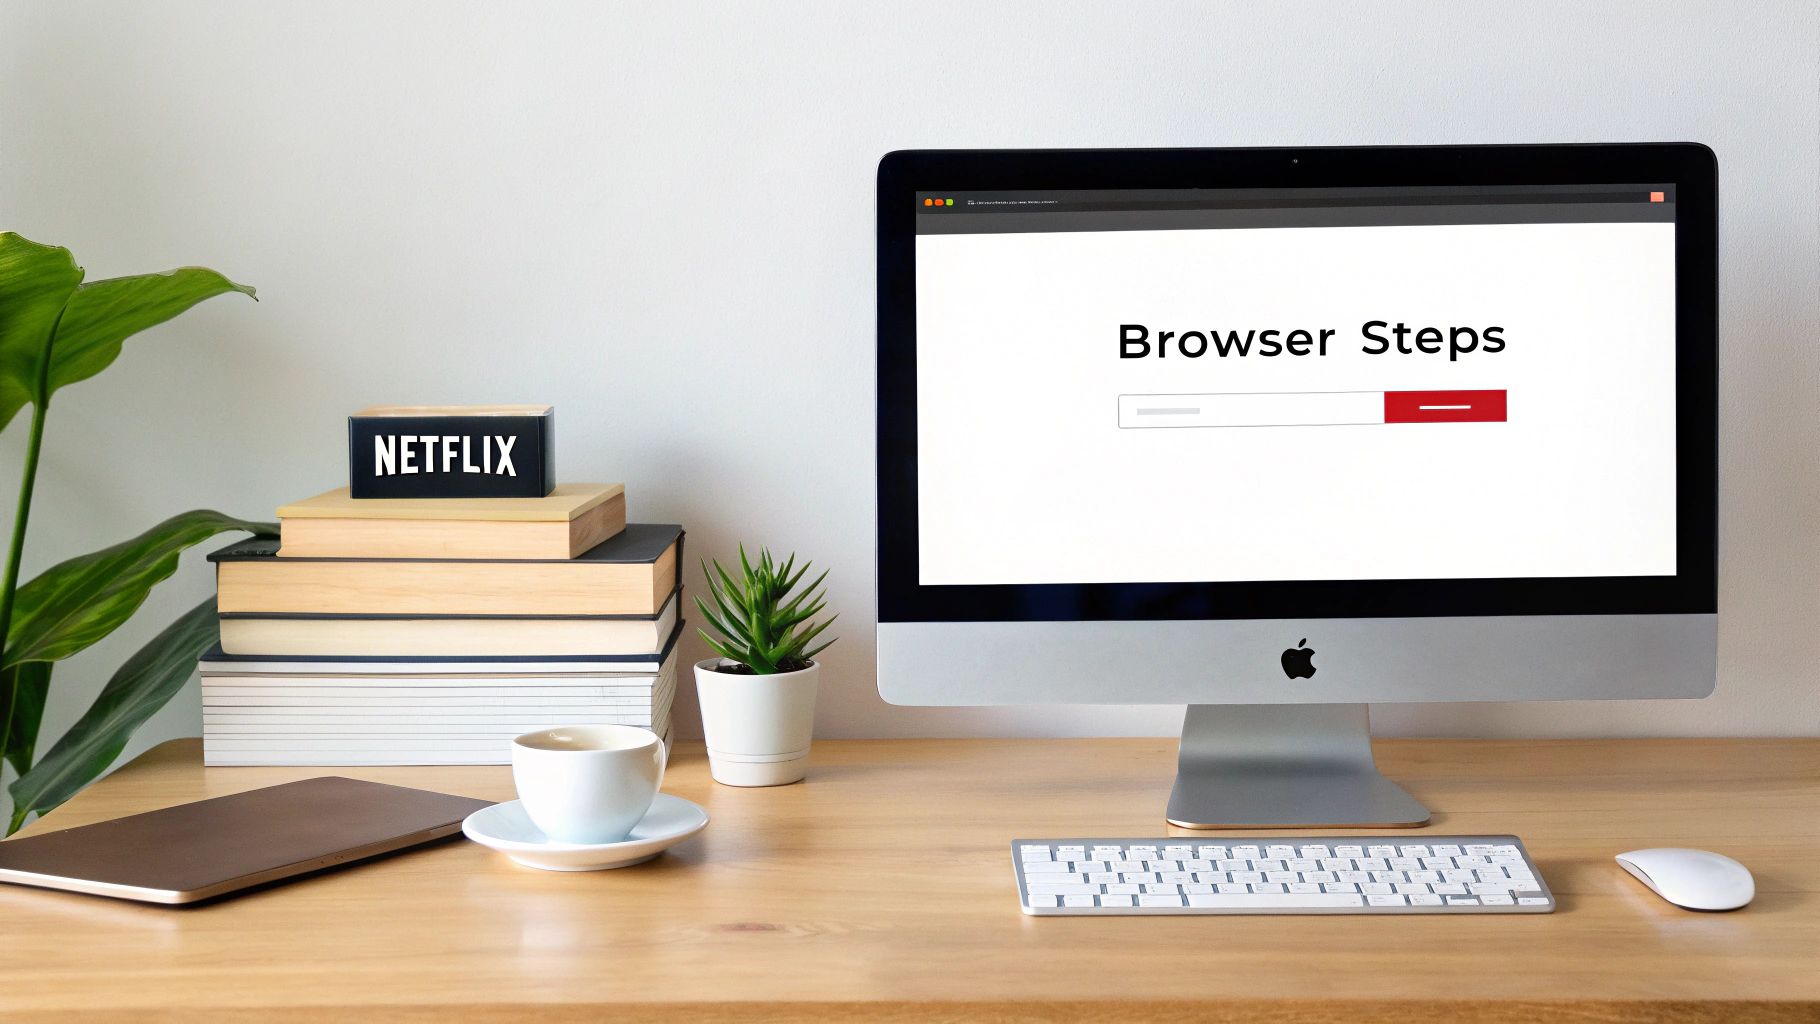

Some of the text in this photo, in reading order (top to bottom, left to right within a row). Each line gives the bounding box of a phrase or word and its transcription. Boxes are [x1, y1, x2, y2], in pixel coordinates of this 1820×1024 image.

[1119, 320, 1506, 362] Browser Steps
[374, 434, 517, 477] NETFLIX
